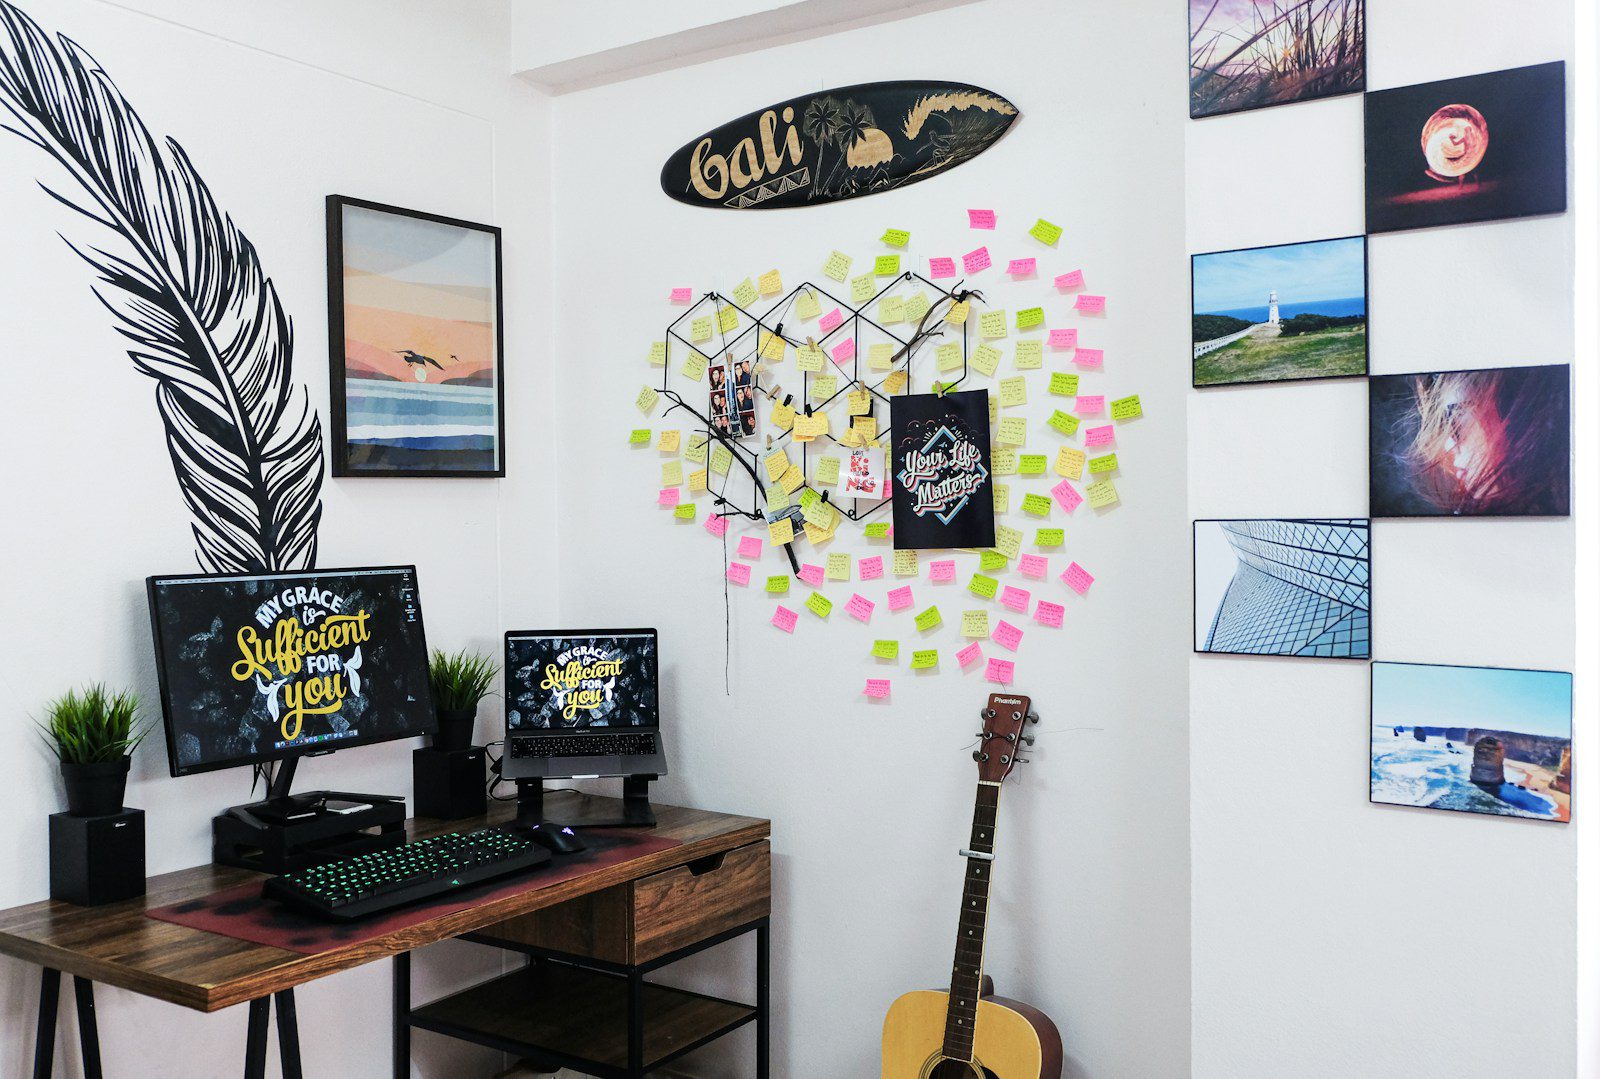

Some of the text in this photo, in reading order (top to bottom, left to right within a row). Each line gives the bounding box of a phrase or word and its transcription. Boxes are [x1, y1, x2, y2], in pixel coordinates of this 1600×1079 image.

[903, 440, 979, 488] Your Life
[913, 471, 981, 512] Matters
[255, 586, 344, 629] MY GRACE
[302, 605, 326, 626] is
[231, 609, 371, 682] Sufficient
[556, 646, 609, 666] MY GRACE
[582, 655, 598, 666] is
[306, 653, 341, 674] FOR
[540, 658, 624, 690] Sufficient
[581, 680, 602, 689] FOR
[281, 673, 347, 741] you
[563, 689, 604, 720] you
